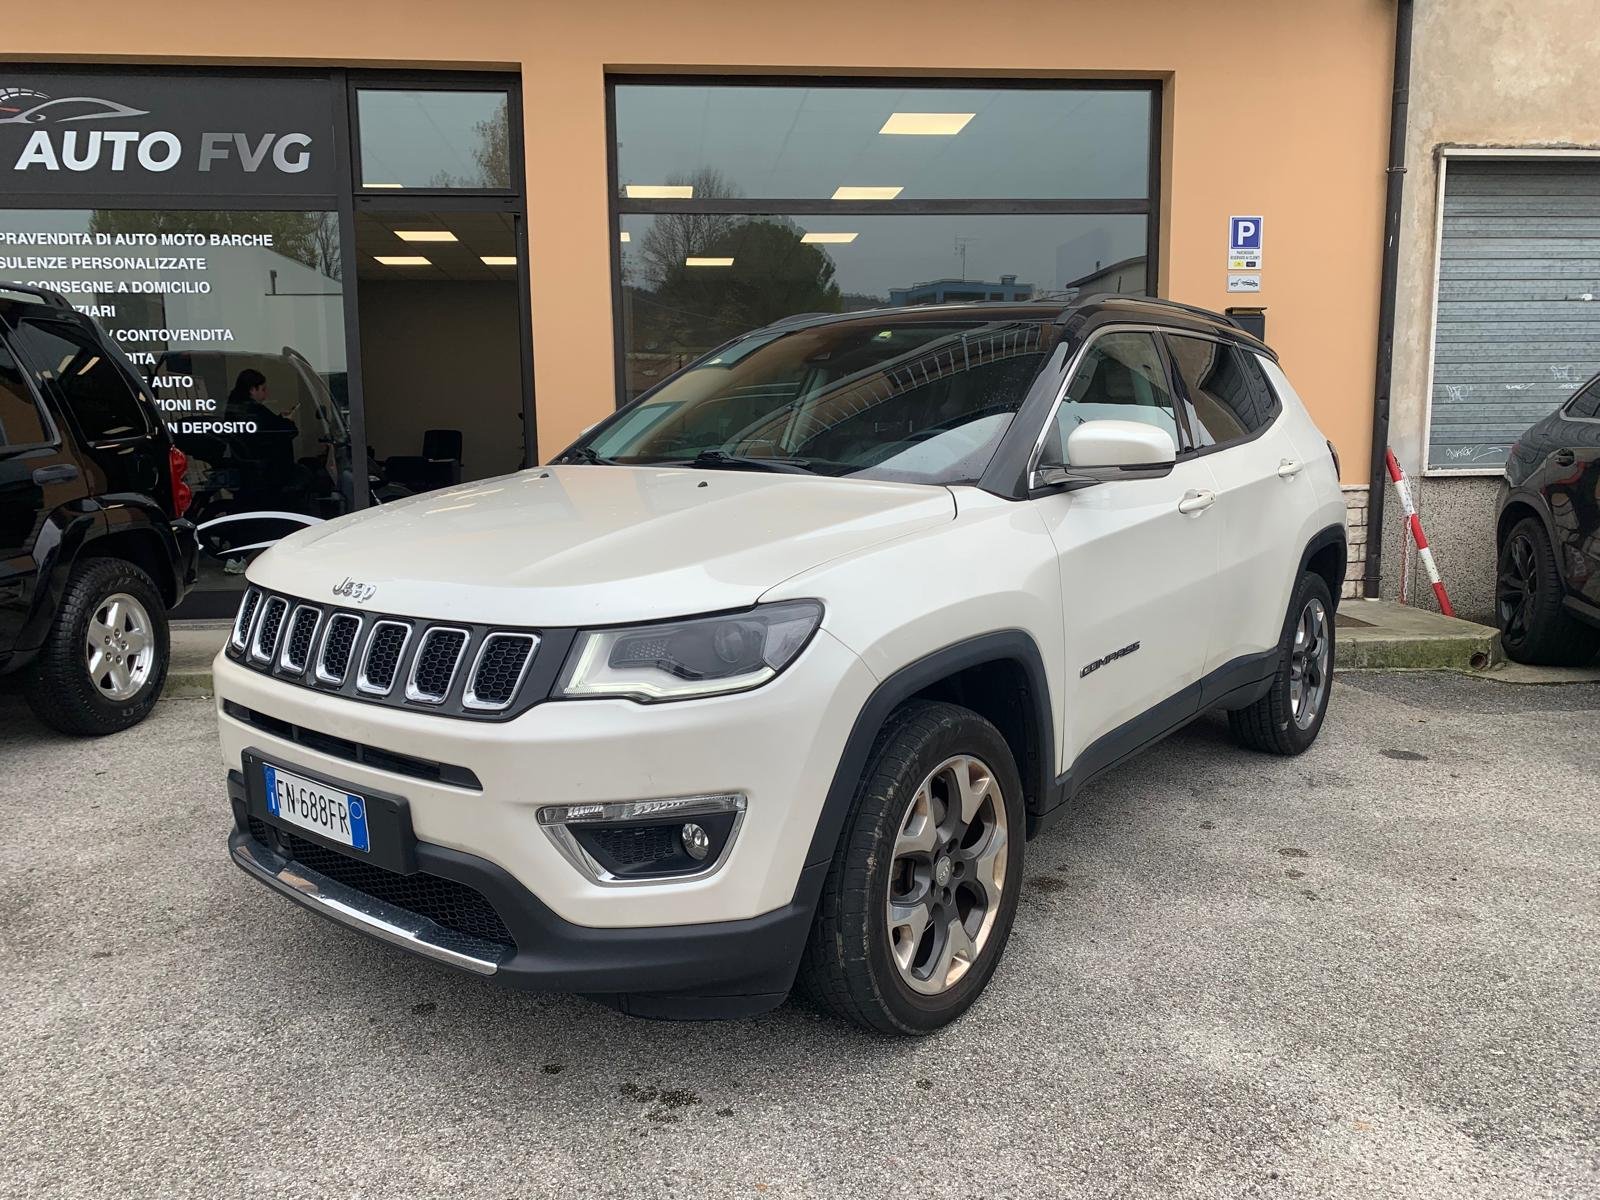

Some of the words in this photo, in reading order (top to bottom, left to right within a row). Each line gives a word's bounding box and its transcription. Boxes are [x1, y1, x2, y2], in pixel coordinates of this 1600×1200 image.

[14, 130, 182, 172] AUTO
[198, 132, 313, 173] FVG
[1238, 221, 1255, 245] P
[96, 233, 111, 245] DI
[115, 233, 157, 246] AUTO
[162, 234, 206, 246] MOTO
[210, 234, 274, 247] BARCHE
[71, 257, 207, 270] PERSONALIZZATE
[118, 281, 129, 293] A
[132, 281, 211, 294] DOMICILIO
[116, 329, 234, 342] CONTOVENDITA
[152, 375, 193, 388] AUTO
[195, 399, 217, 411] RC
[181, 421, 257, 434] DEPOSITO
[332, 576, 377, 603] Jeep
